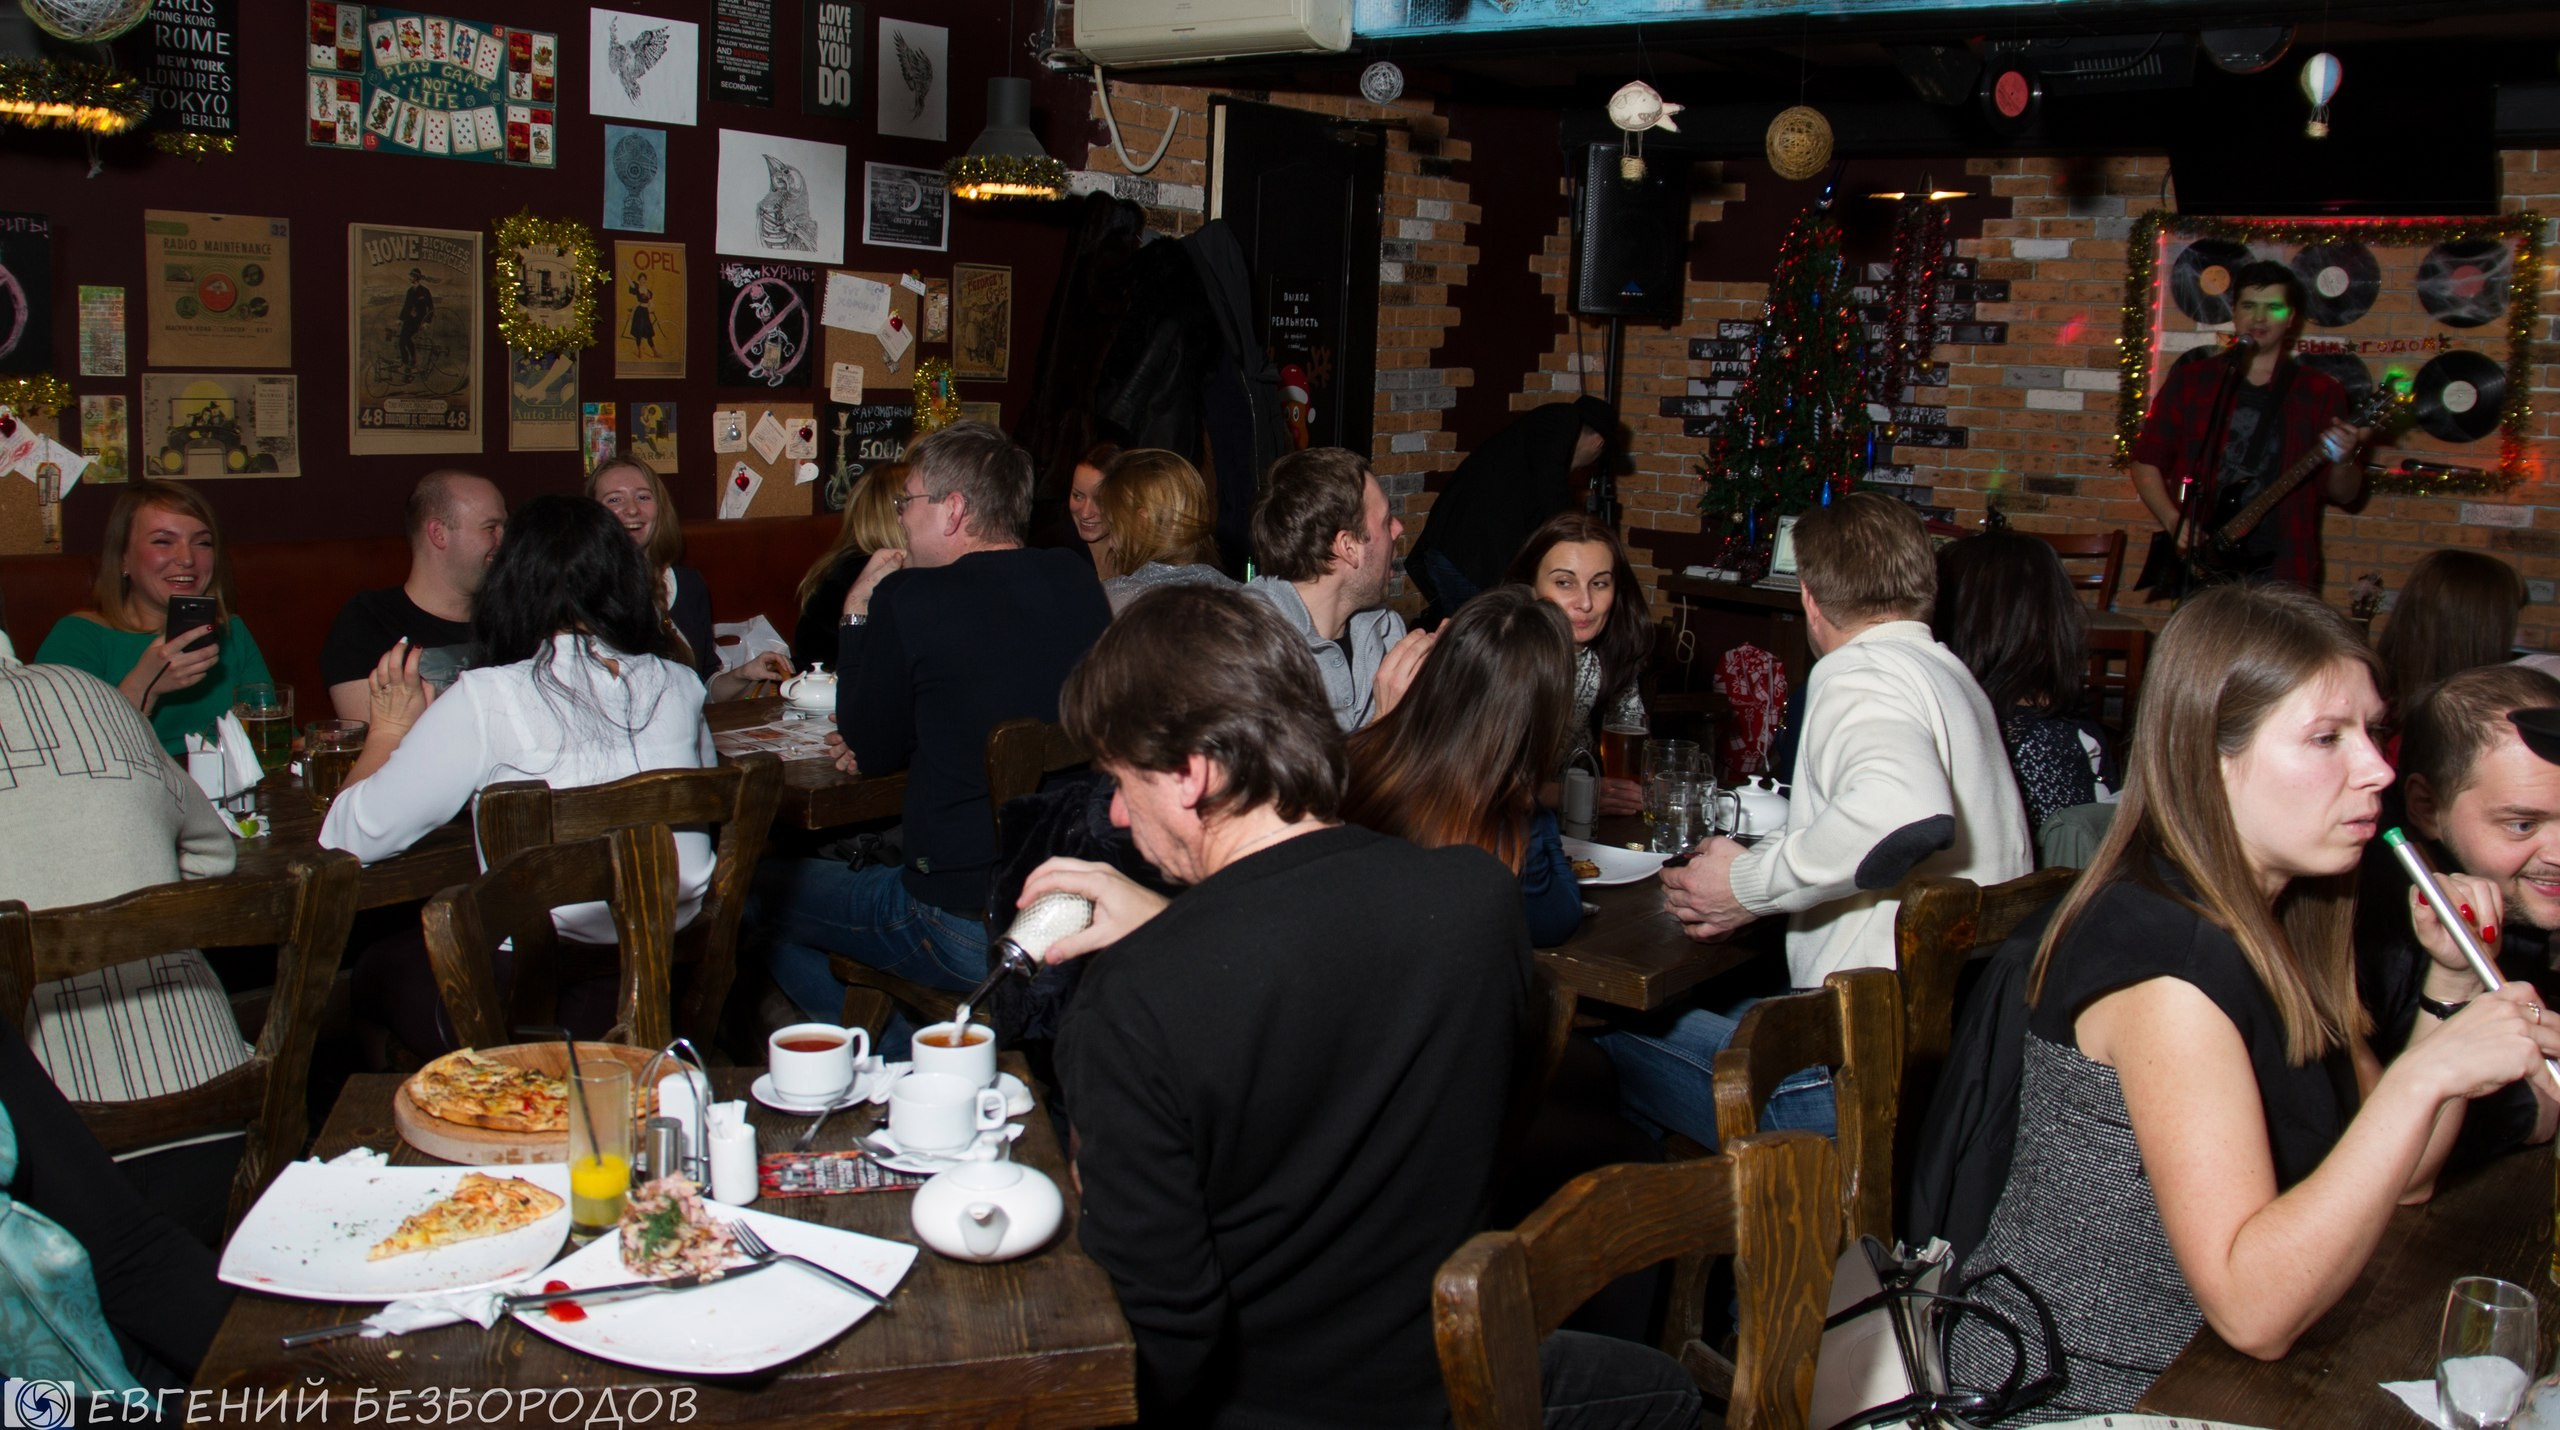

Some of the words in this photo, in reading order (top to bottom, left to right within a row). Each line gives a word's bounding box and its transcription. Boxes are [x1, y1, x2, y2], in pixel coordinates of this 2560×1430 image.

[149, 11, 182, 23] HONG
[184, 13, 217, 28] KONG
[819, 2, 852, 29] LOVE
[155, 24, 231, 55] ROME
[818, 23, 852, 44] WHAT
[716, 46, 733, 55] AND
[818, 39, 852, 70] YOU
[157, 53, 189, 69] NEW
[191, 56, 226, 73] YORK
[146, 66, 232, 92] LONDRES
[382, 61, 431, 81] PLAY
[441, 66, 491, 92] GAME
[422, 77, 451, 93] NOT
[739, 74, 746, 82] IS
[818, 65, 852, 109] DO
[145, 86, 229, 115] TOKYO
[407, 87, 460, 109] LIFE
[181, 112, 231, 129] BERLIN
[271, 223, 287, 237] 32
[163, 238, 197, 251] RADIO
[204, 240, 272, 255] MAINTENANCE
[365, 235, 420, 267] HOWE
[422, 236, 470, 261] BICYCLES
[421, 247, 471, 275] TRICYCLES
[633, 250, 681, 275] OPEL
[1283, 291, 1310, 303] ВЫХОД
[1271, 316, 1319, 328] РЕАЛЬНОСТЬ
[2361, 337, 2436, 354] ГОДОМ
[361, 408, 384, 426] 48
[447, 410, 467, 427] 48
[513, 407, 576, 420] Auto-Lite
